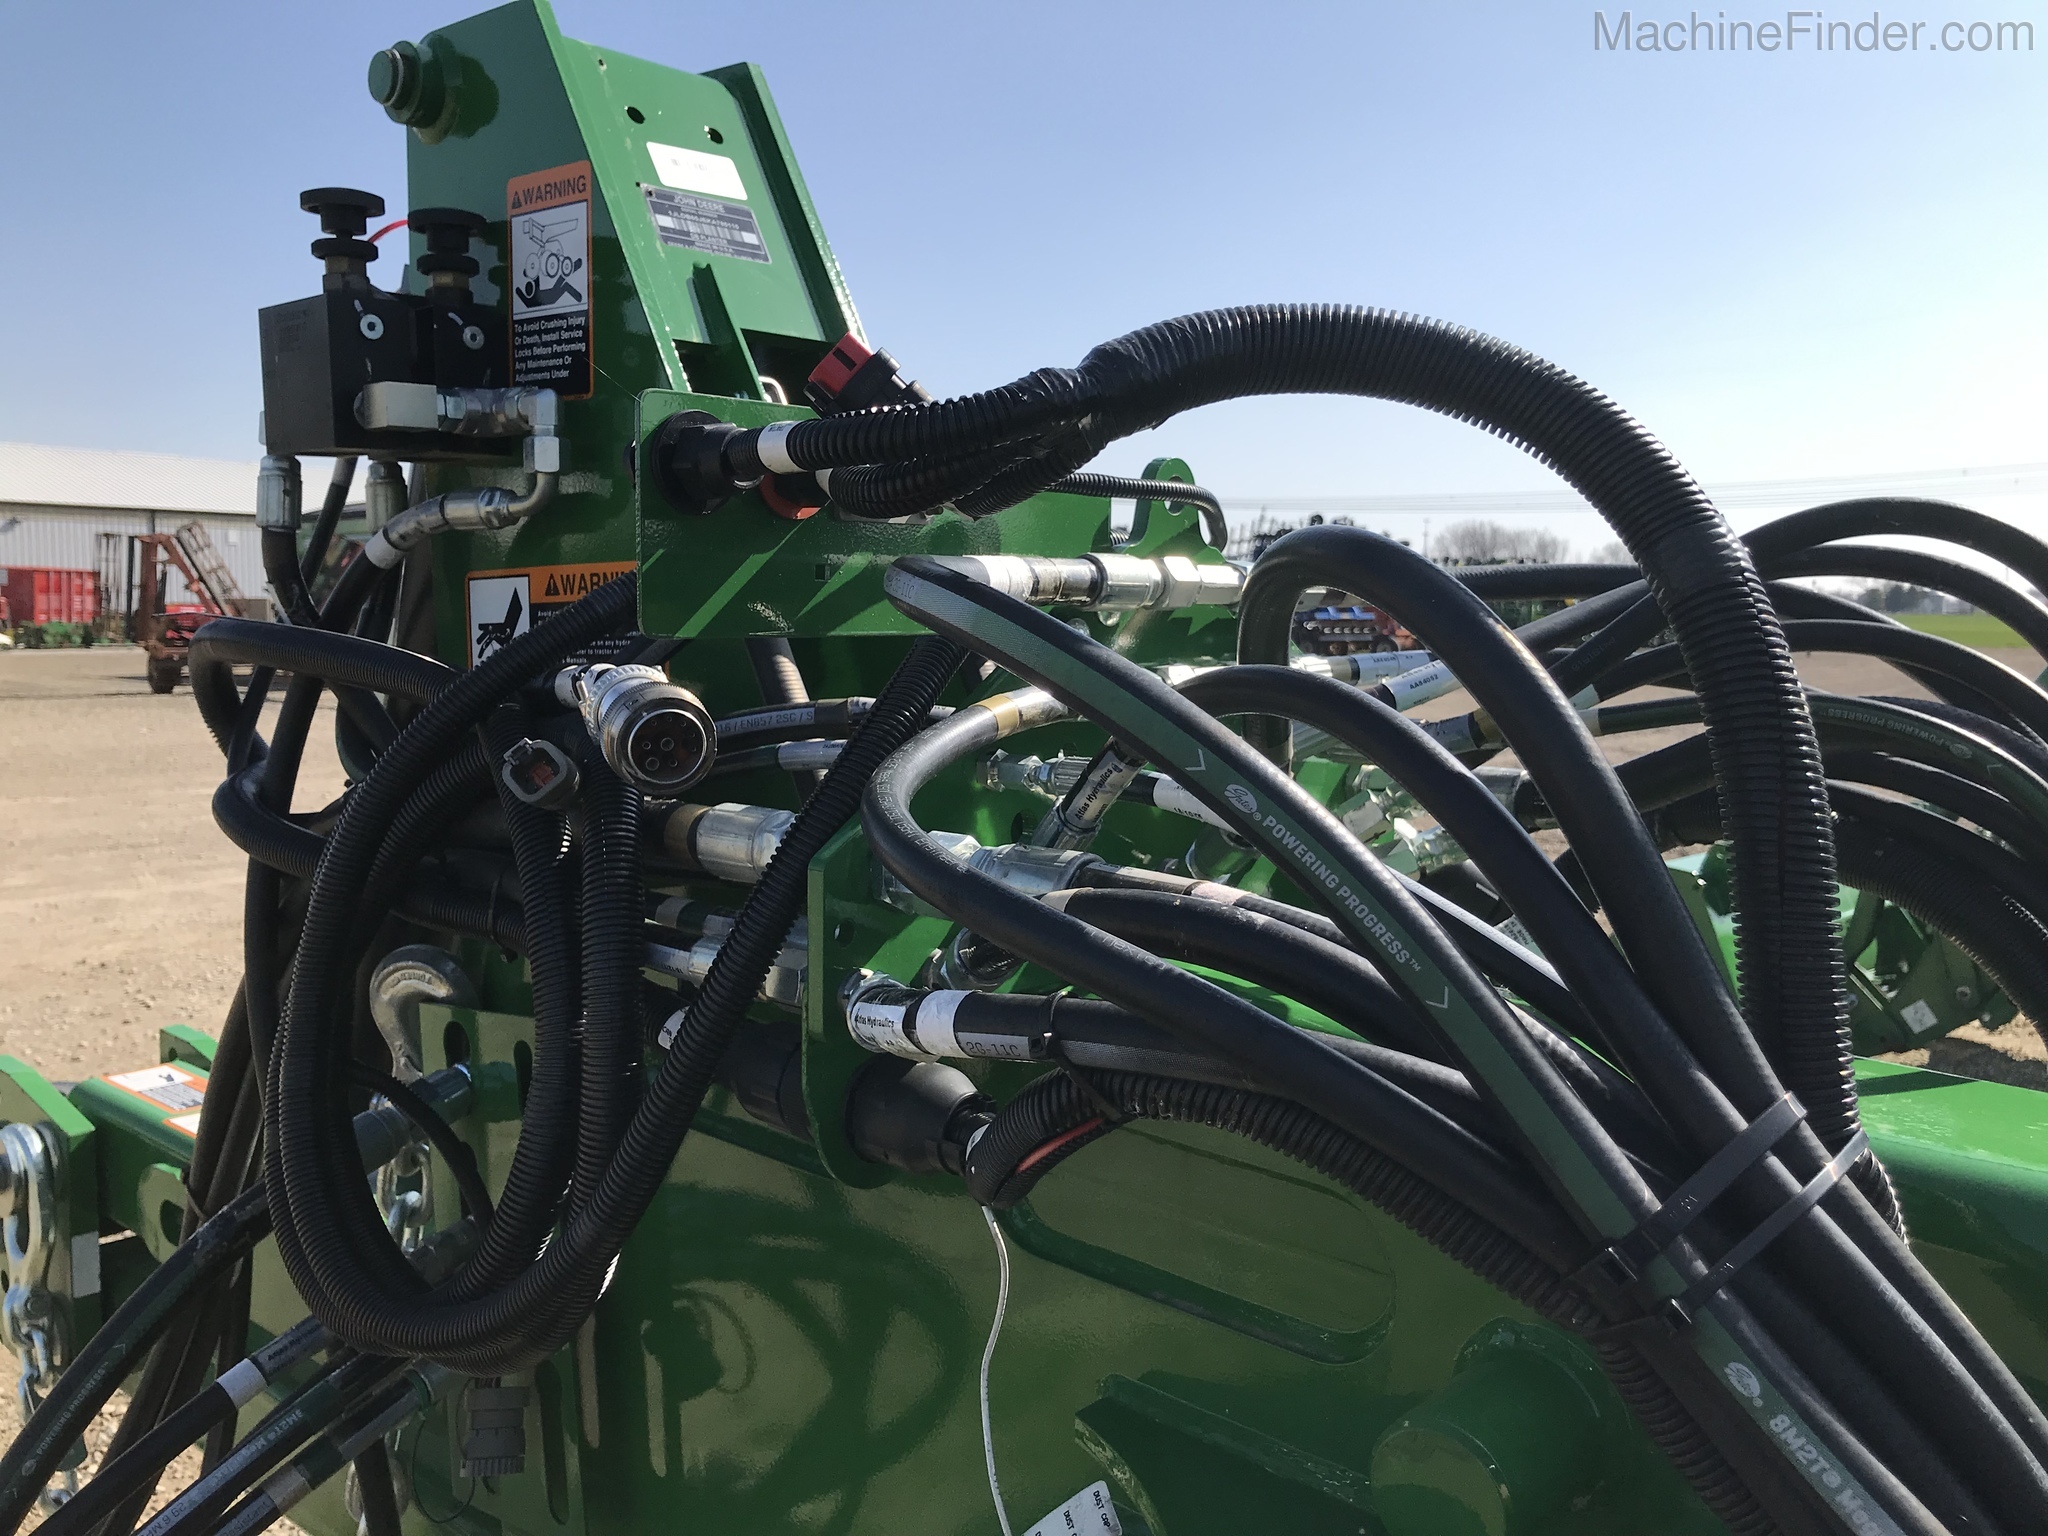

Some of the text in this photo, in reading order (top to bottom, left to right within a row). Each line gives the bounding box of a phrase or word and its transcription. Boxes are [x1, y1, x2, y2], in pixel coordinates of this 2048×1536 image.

[522, 175, 587, 205] WARNING
[674, 194, 697, 206] JOHN
[514, 316, 585, 333] To Avoid Crushing Injury
[514, 337, 521, 345] Or
[542, 331, 559, 341] Install
[561, 329, 583, 339] Service
[514, 342, 586, 358] Locks Before Performing
[515, 355, 572, 371] Any Maintenance Or
[515, 369, 569, 383] Adjustments Under
[560, 571, 625, 596] WARN
[740, 715, 774, 731] EN857
[775, 711, 797, 724] 2SC
[1074, 802, 1090, 821] Atlas
[1087, 768, 1113, 803] Hydraulics
[1262, 815, 1339, 889] POWERING
[855, 1013, 895, 1029] Atlas Hydraulics
[1093, 1490, 1111, 1528] DUST CAP
[1063, 1510, 1075, 1530] DUST
